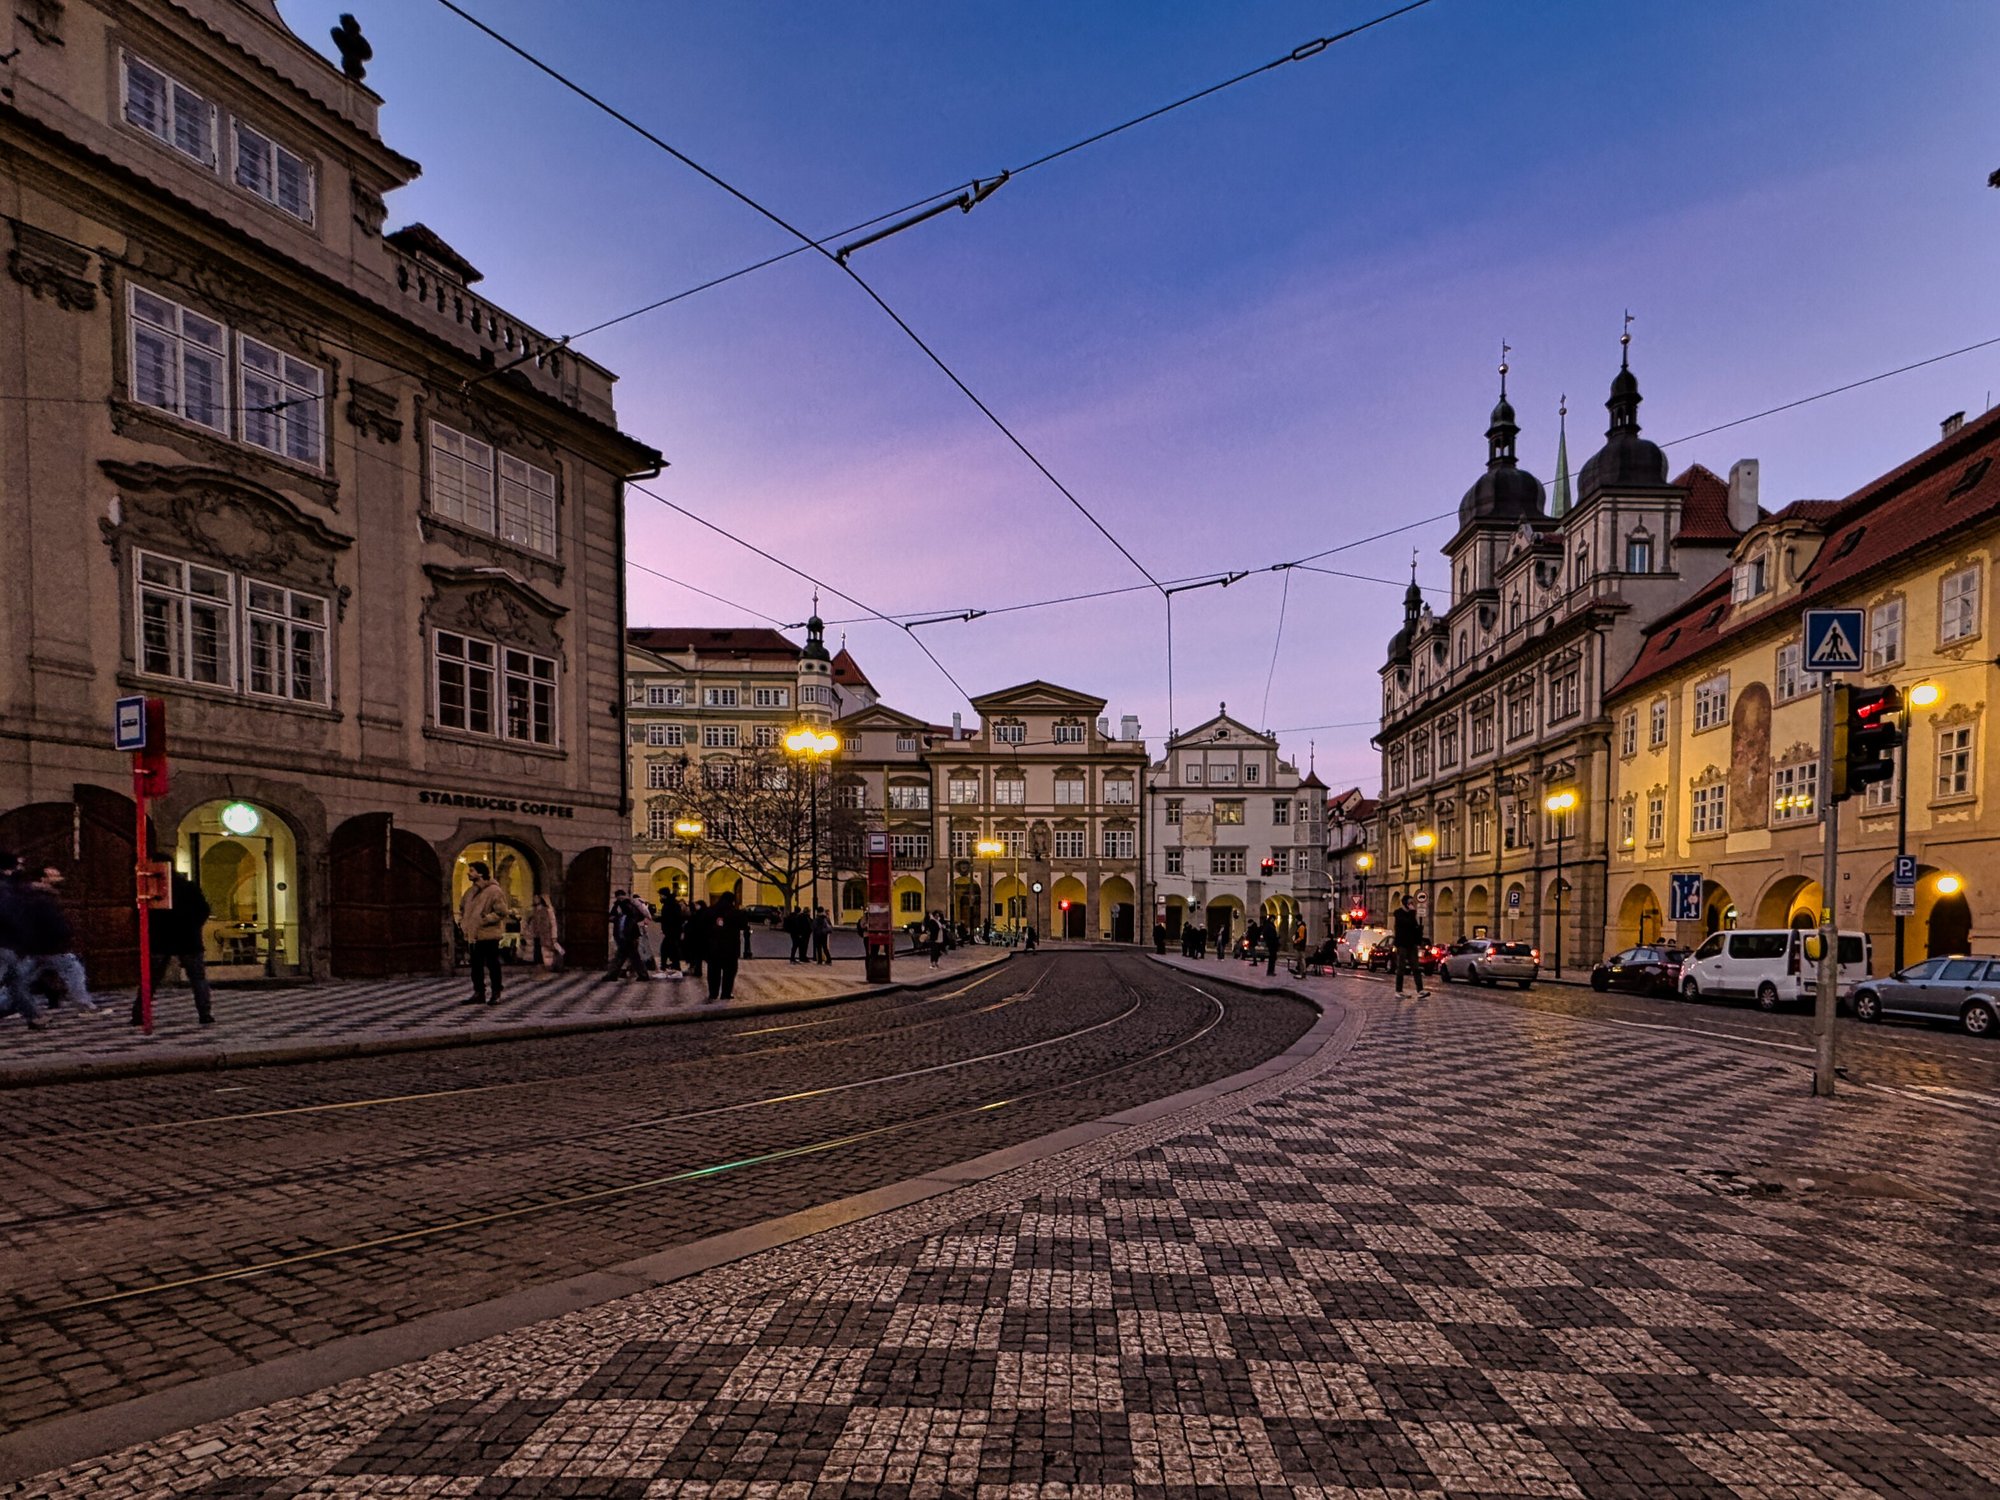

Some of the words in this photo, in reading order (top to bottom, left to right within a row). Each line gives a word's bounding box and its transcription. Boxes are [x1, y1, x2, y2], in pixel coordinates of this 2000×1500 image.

[418, 791, 517, 812] STARBUCKS
[520, 802, 574, 818] COFFEE
[1899, 859, 1912, 876] P
[1511, 893, 1519, 903] P
